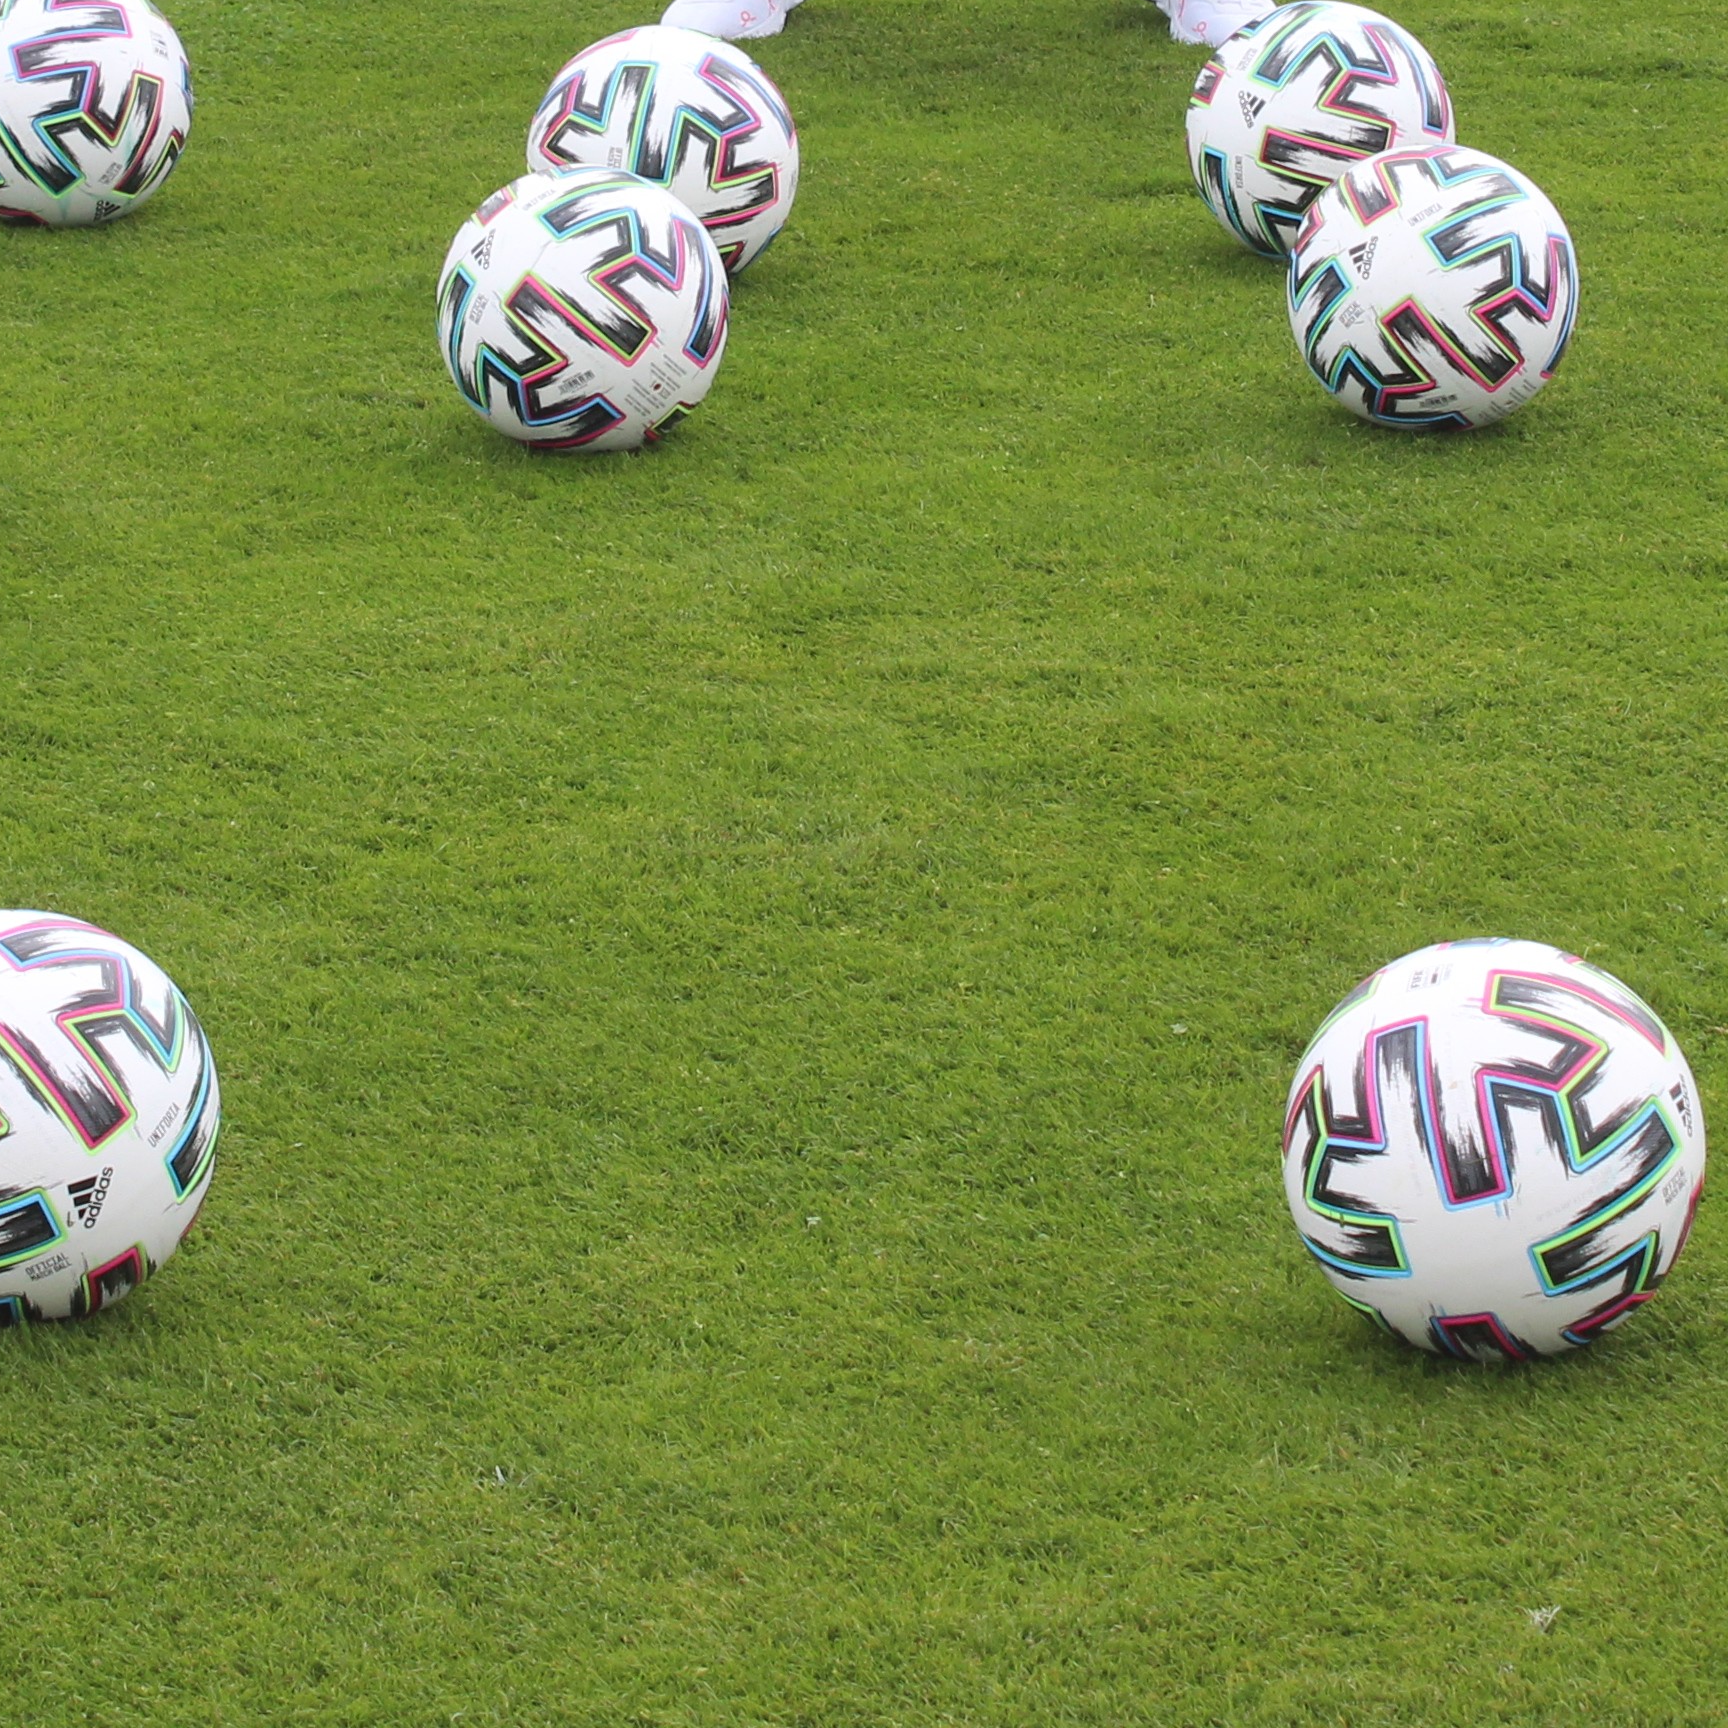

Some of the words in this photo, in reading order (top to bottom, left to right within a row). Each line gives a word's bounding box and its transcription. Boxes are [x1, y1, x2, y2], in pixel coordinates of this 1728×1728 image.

[1238, 90, 1254, 129] adidas
[482, 228, 496, 270] adidas
[1361, 235, 1379, 280] adidas
[146, 1101, 181, 1149] UNIFORIA
[83, 1165, 114, 1229] adidas
[24, 1252, 69, 1276] OFFICIAL
